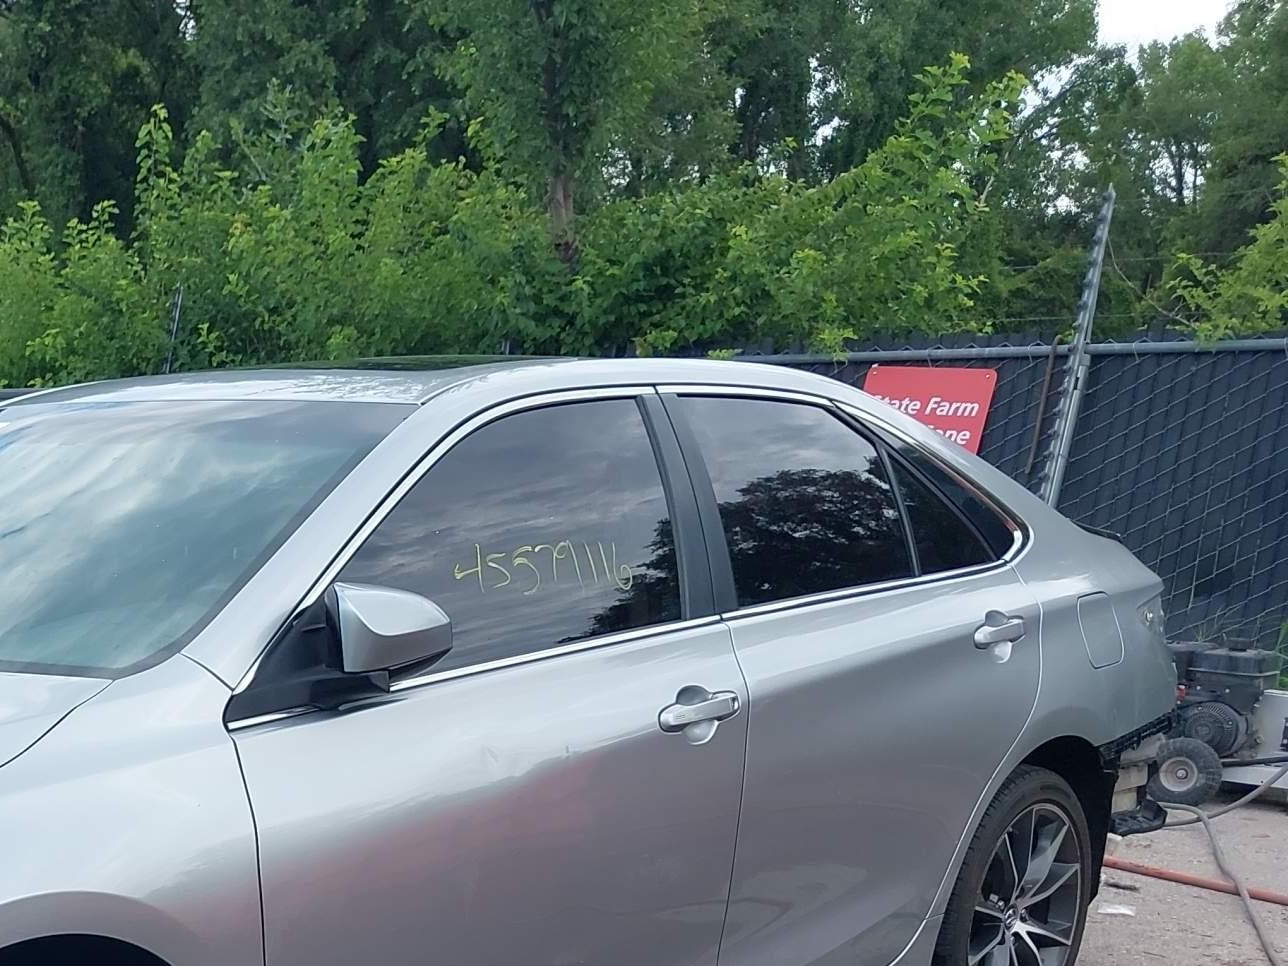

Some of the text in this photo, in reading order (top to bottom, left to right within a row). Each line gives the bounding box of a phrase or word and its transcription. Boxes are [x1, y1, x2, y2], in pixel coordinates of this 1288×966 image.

[924, 397, 979, 416] Farm
[928, 425, 971, 445] ne
[453, 539, 633, 595] 45579116
